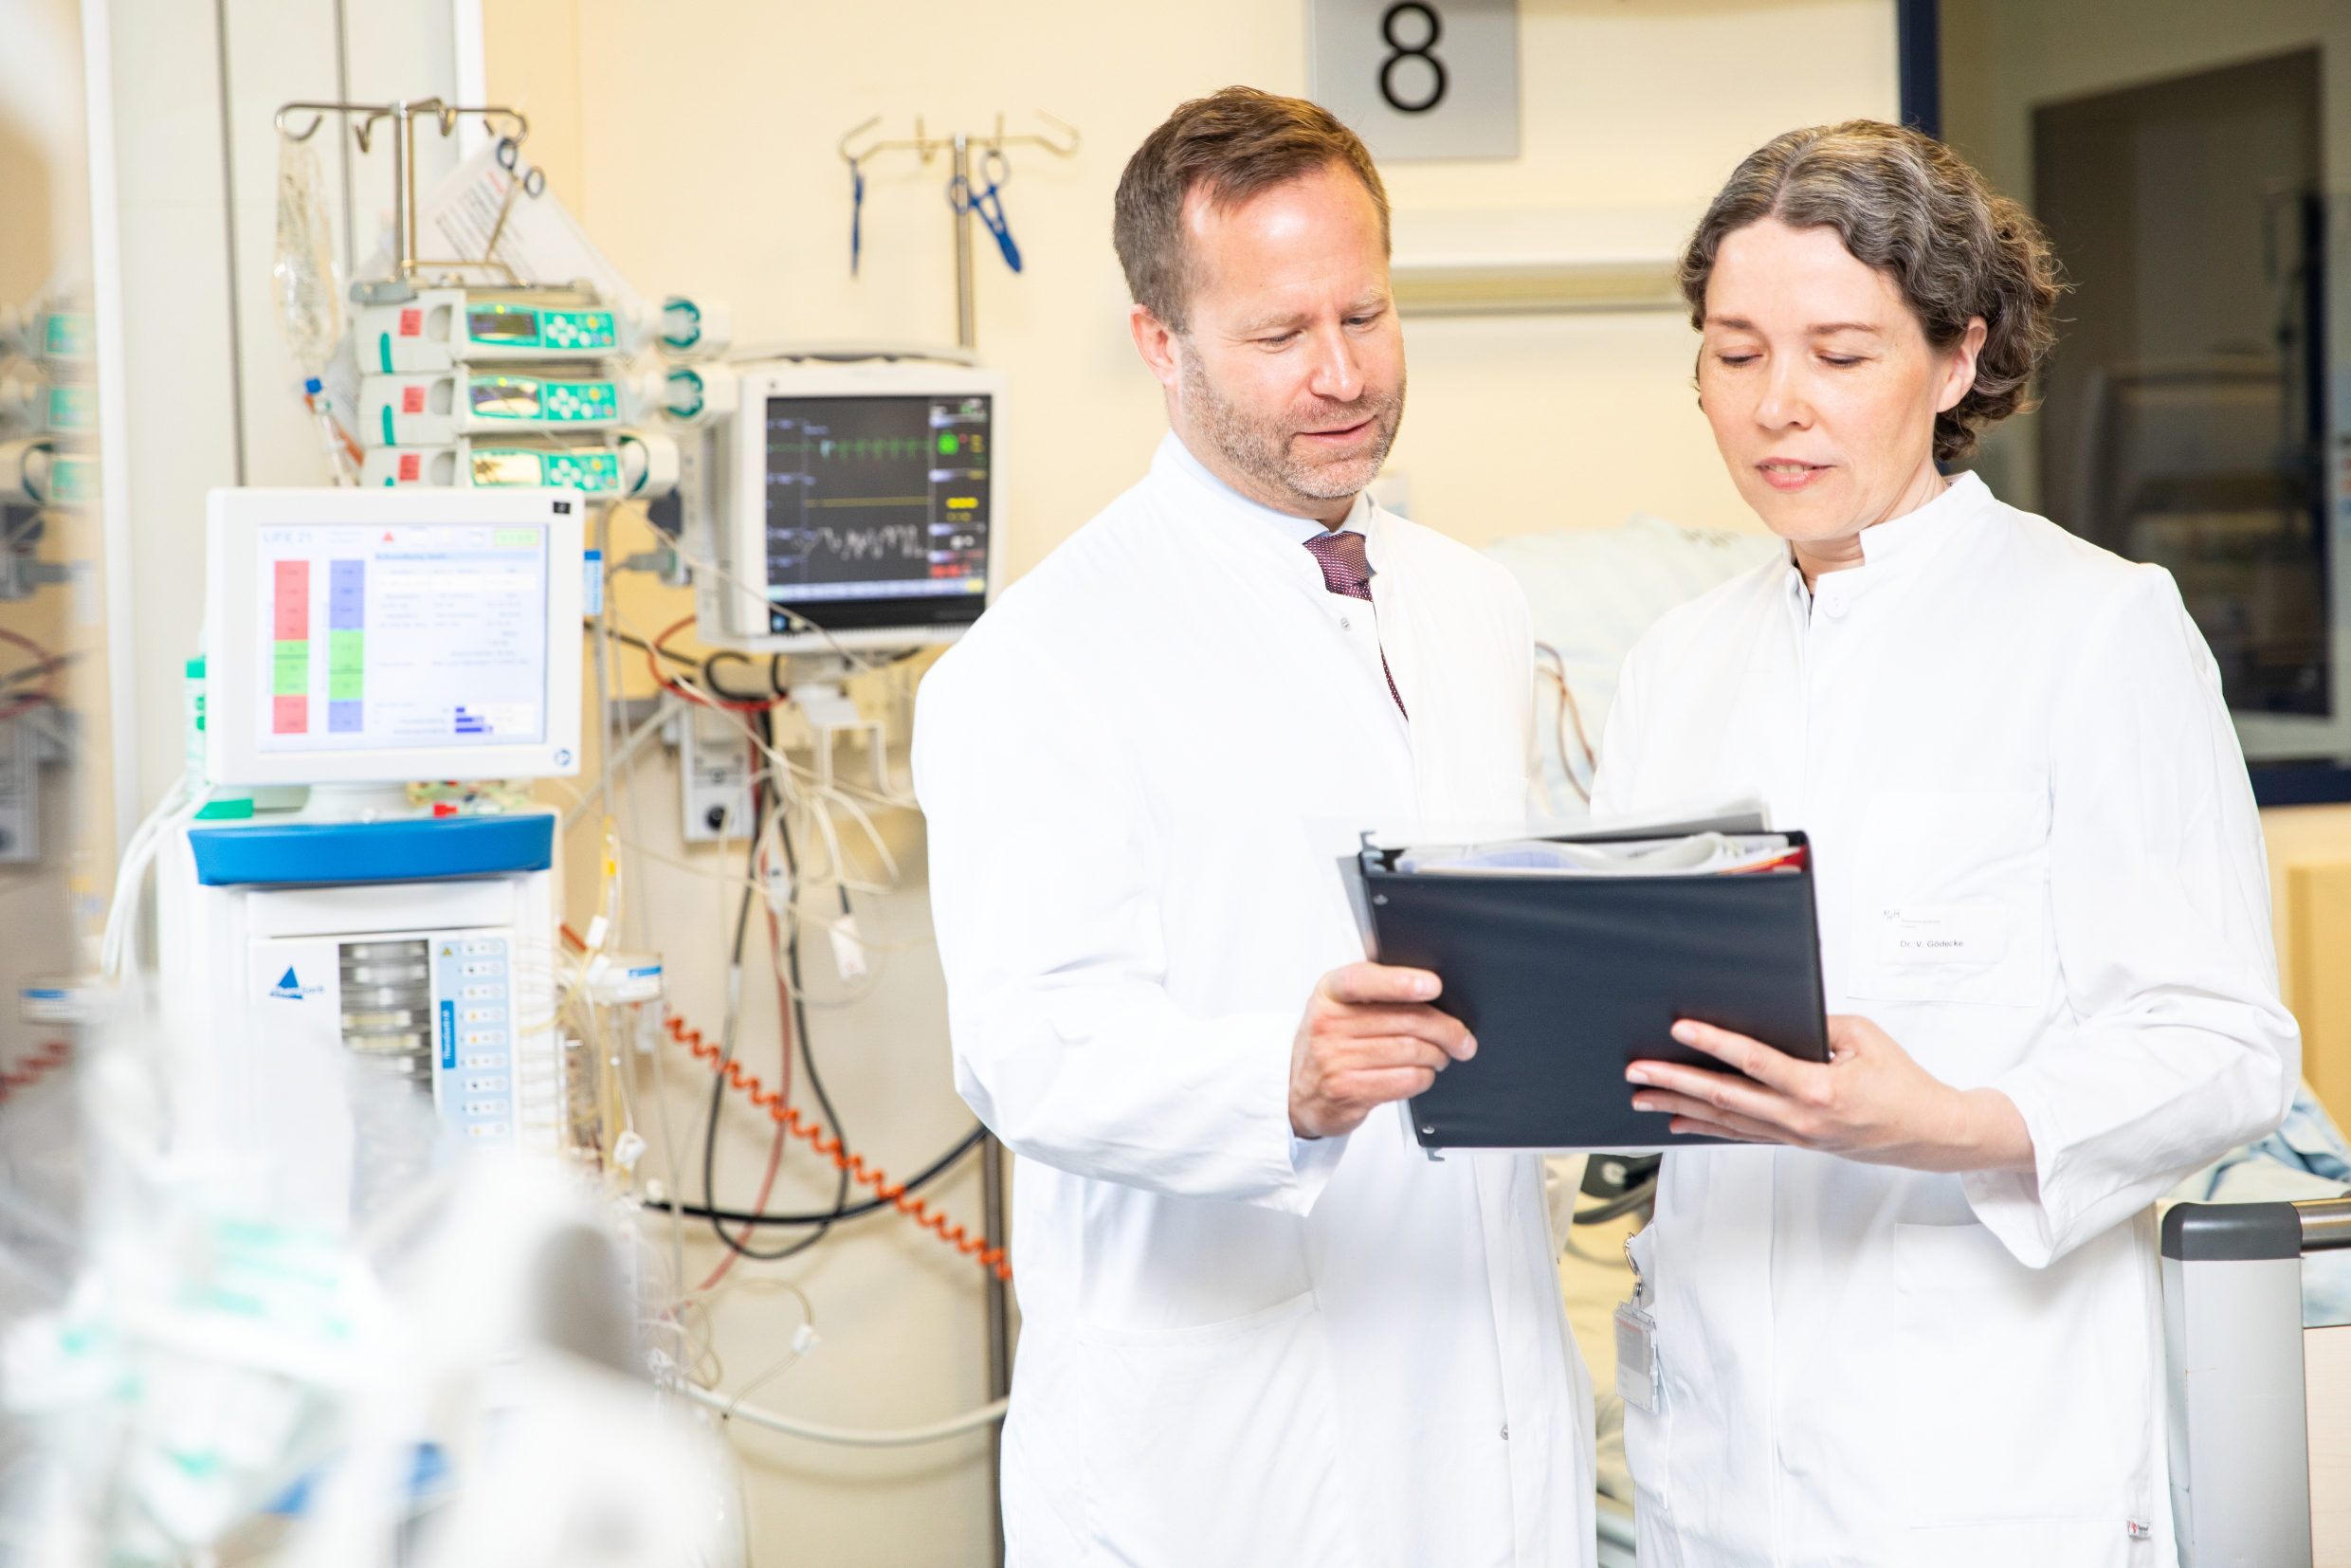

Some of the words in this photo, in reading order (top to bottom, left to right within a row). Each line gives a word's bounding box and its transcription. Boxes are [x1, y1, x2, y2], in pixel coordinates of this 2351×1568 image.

[1378, 1, 1448, 114] 8
[264, 531, 293, 543] LIFE
[1900, 939, 1913, 948] Dr.
[1916, 939, 1924, 948] V.
[1926, 939, 1964, 948] Gödecke
